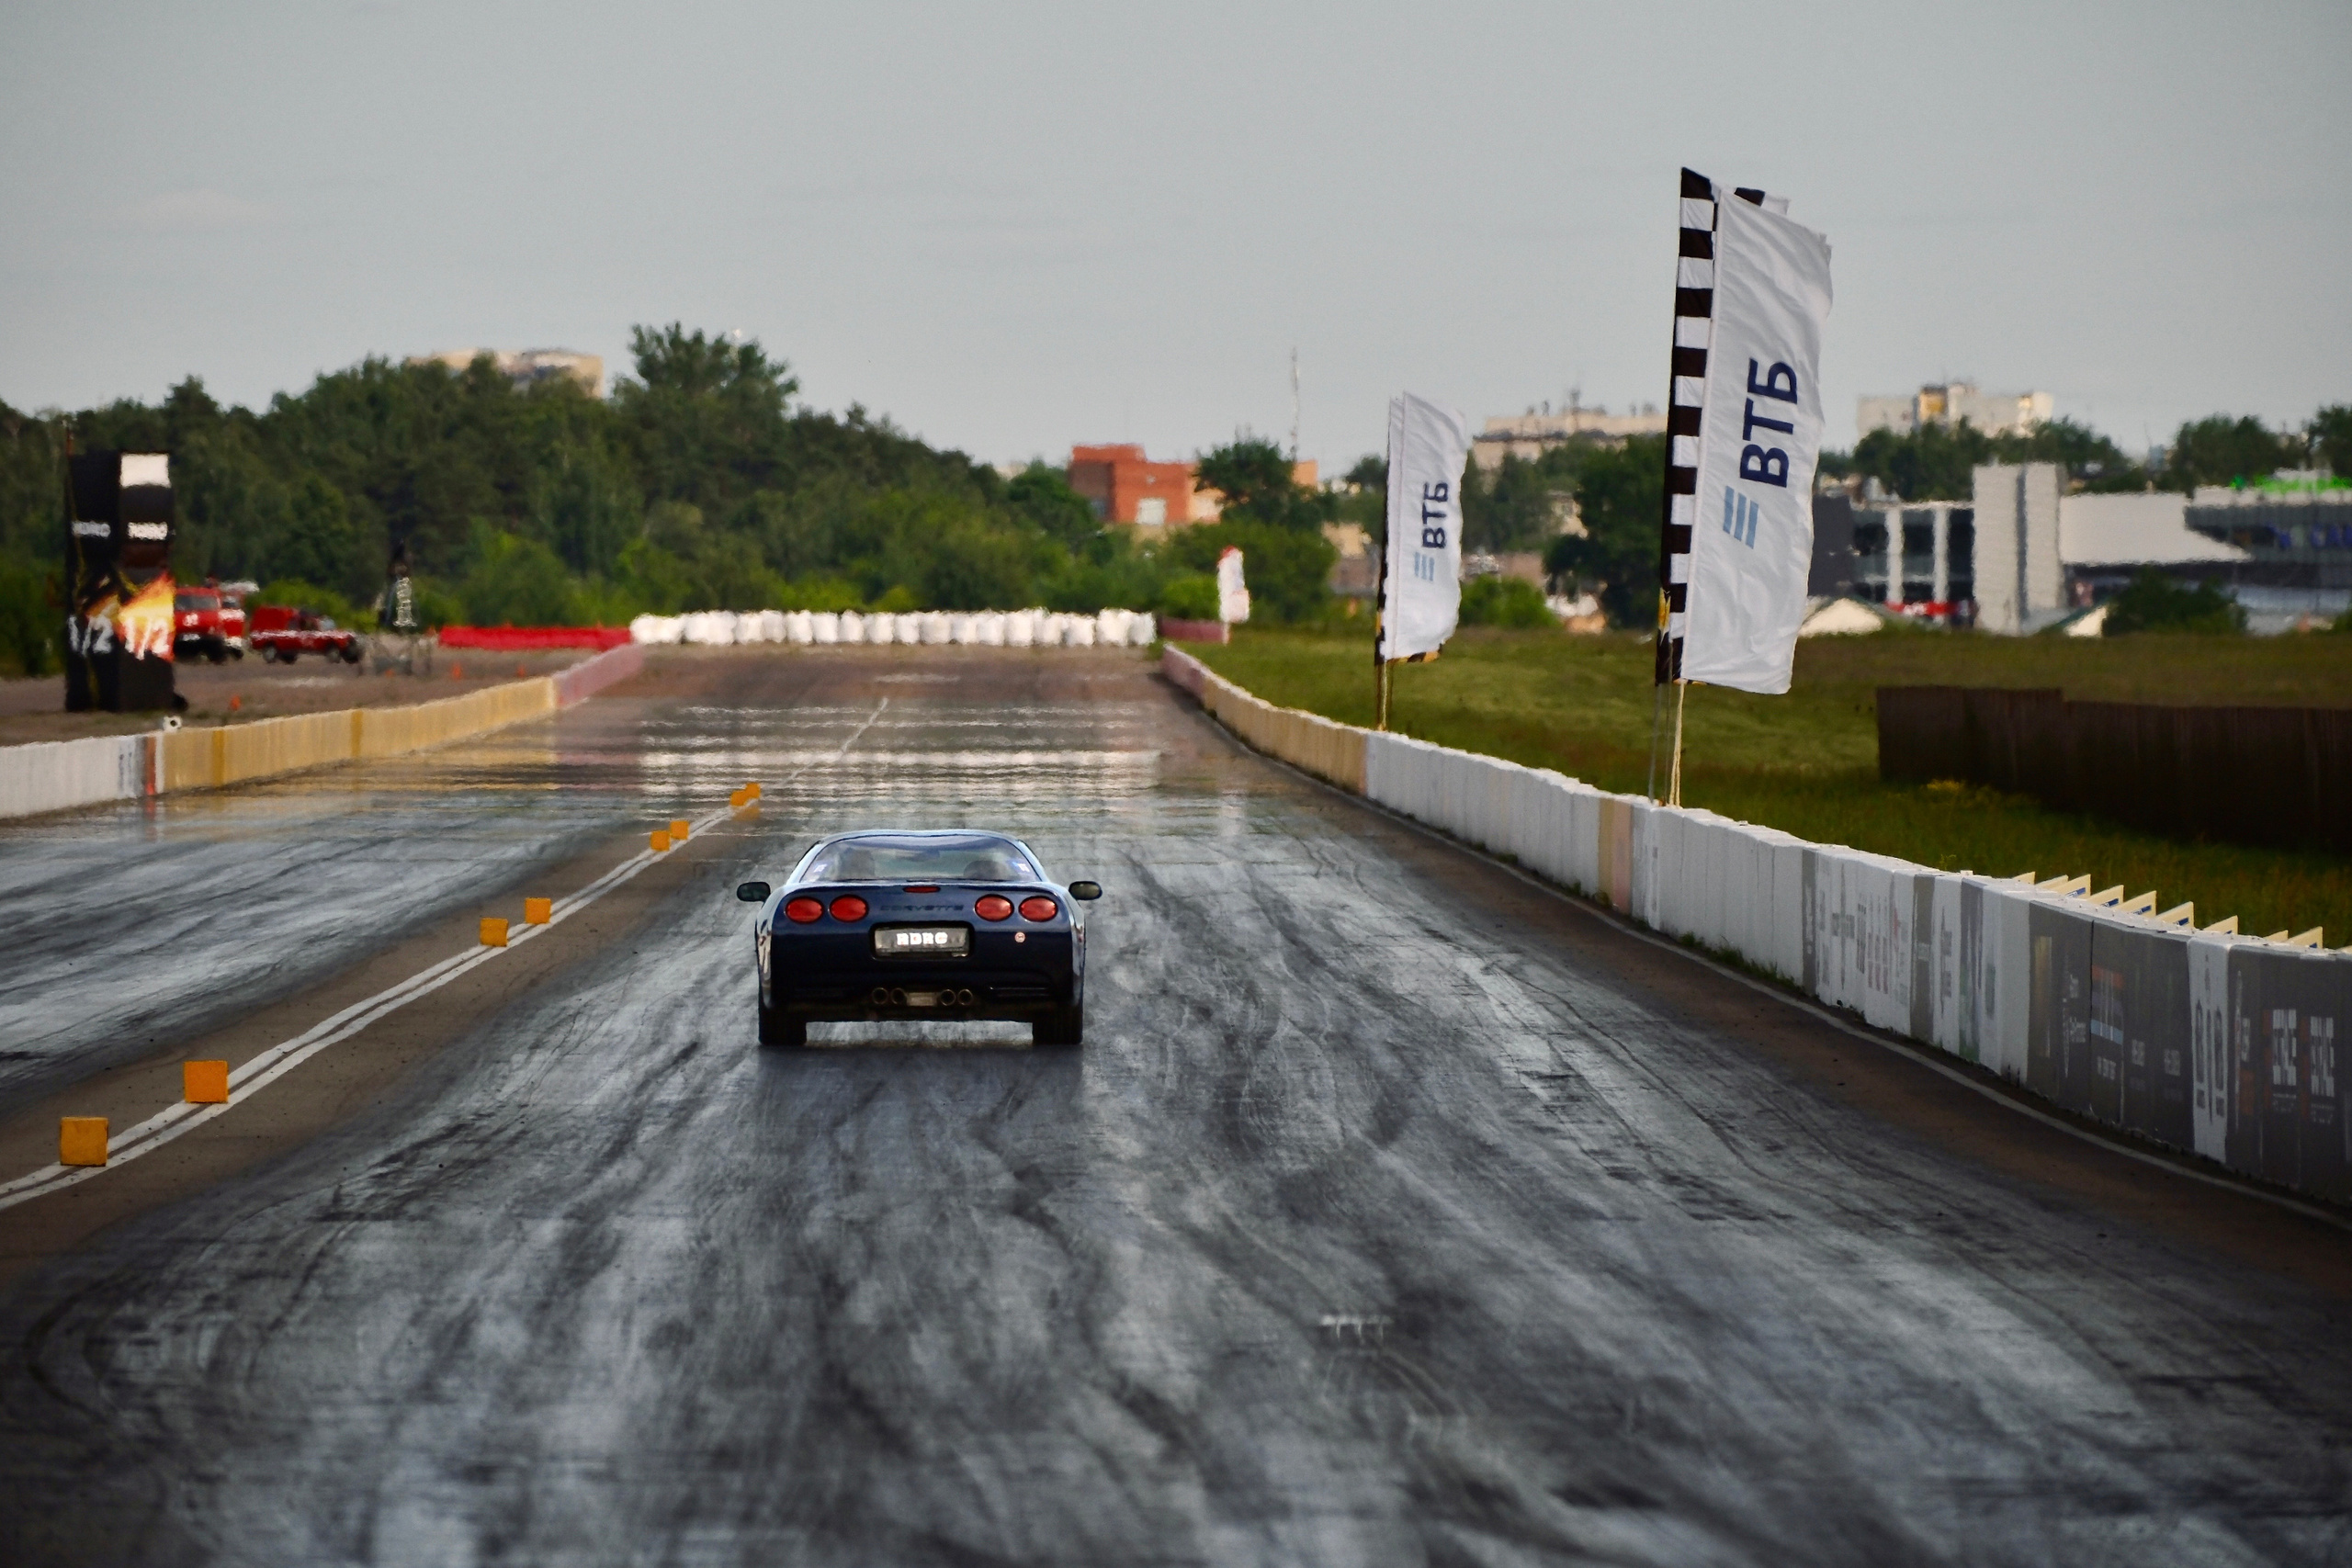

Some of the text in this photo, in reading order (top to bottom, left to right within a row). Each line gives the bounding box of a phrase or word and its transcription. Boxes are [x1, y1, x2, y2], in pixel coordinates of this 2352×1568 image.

[1739, 357, 1798, 488] ВТБ
[1422, 482, 1449, 548] ВТБ
[68, 614, 114, 659] 1/2
[124, 615, 169, 660] 1/2
[880, 904, 965, 912] CORVETTE
